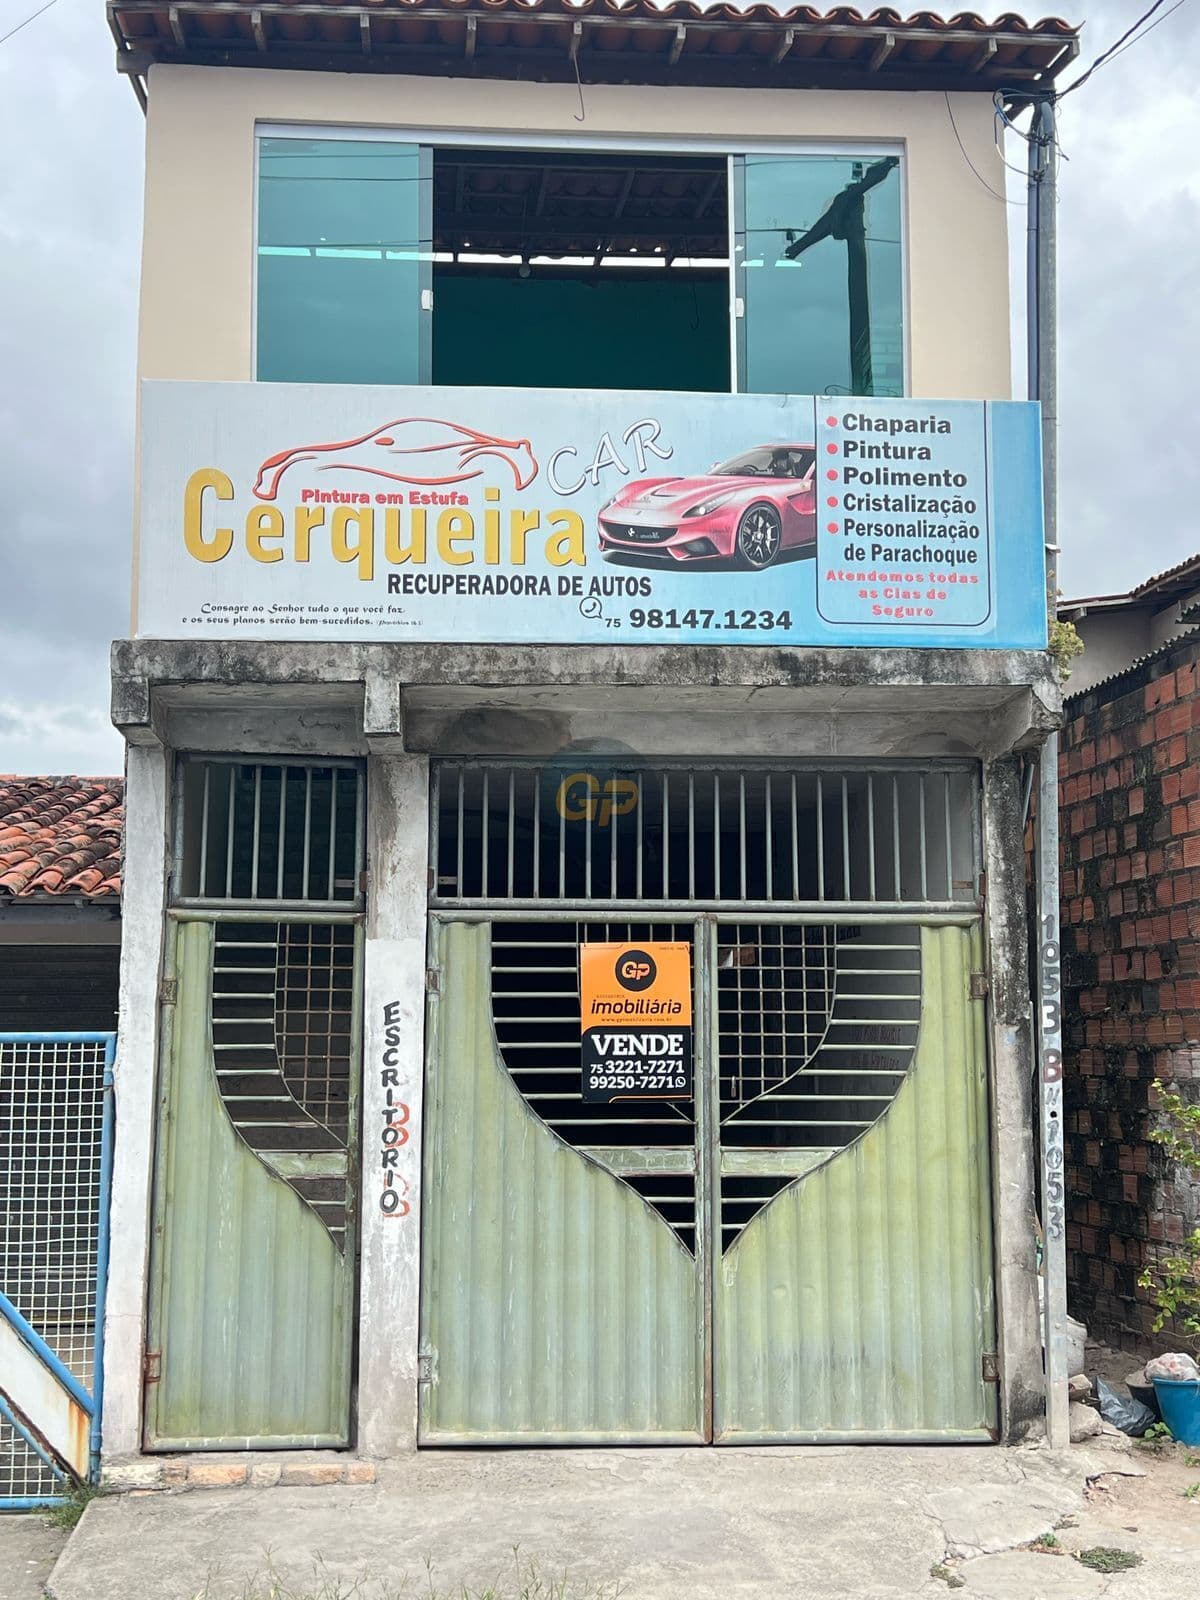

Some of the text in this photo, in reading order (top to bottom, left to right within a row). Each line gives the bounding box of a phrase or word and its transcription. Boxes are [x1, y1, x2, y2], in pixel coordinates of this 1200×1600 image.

[842, 413, 951, 435] Chaparia
[547, 418, 674, 496] CAR
[843, 440, 931, 460] Pintura
[843, 466, 968, 487] Polimento
[301, 489, 469, 505] Pintura em Estufa
[843, 493, 976, 518] Cristalização
[183, 466, 587, 581] Cerqueira
[844, 518, 980, 543] Personalização
[844, 543, 978, 566] de Parachoque
[387, 573, 652, 596] RECUPERADORA DE AUTOS
[826, 570, 978, 583] Atendemos todas
[858, 589, 878, 599] as
[926, 588, 947, 599] de
[200, 602, 249, 614] Consagre
[267, 603, 305, 614] Senhor
[308, 604, 329, 613] tudo
[342, 606, 359, 615] que
[363, 605, 384, 613] você
[872, 604, 934, 618] Seguro
[206, 616, 230, 624] seus
[233, 616, 265, 626] planos
[269, 616, 296, 624] serão
[604, 608, 793, 630] 75 98147.1234
[621, 961, 650, 980] GP
[591, 998, 682, 1014] imobiliária
[590, 1034, 684, 1056] VENDE
[590, 1060, 684, 1074] 75 3221-7271
[589, 1075, 674, 1089] 99250-7271
[380, 1001, 400, 1214] ESCRITORIO
